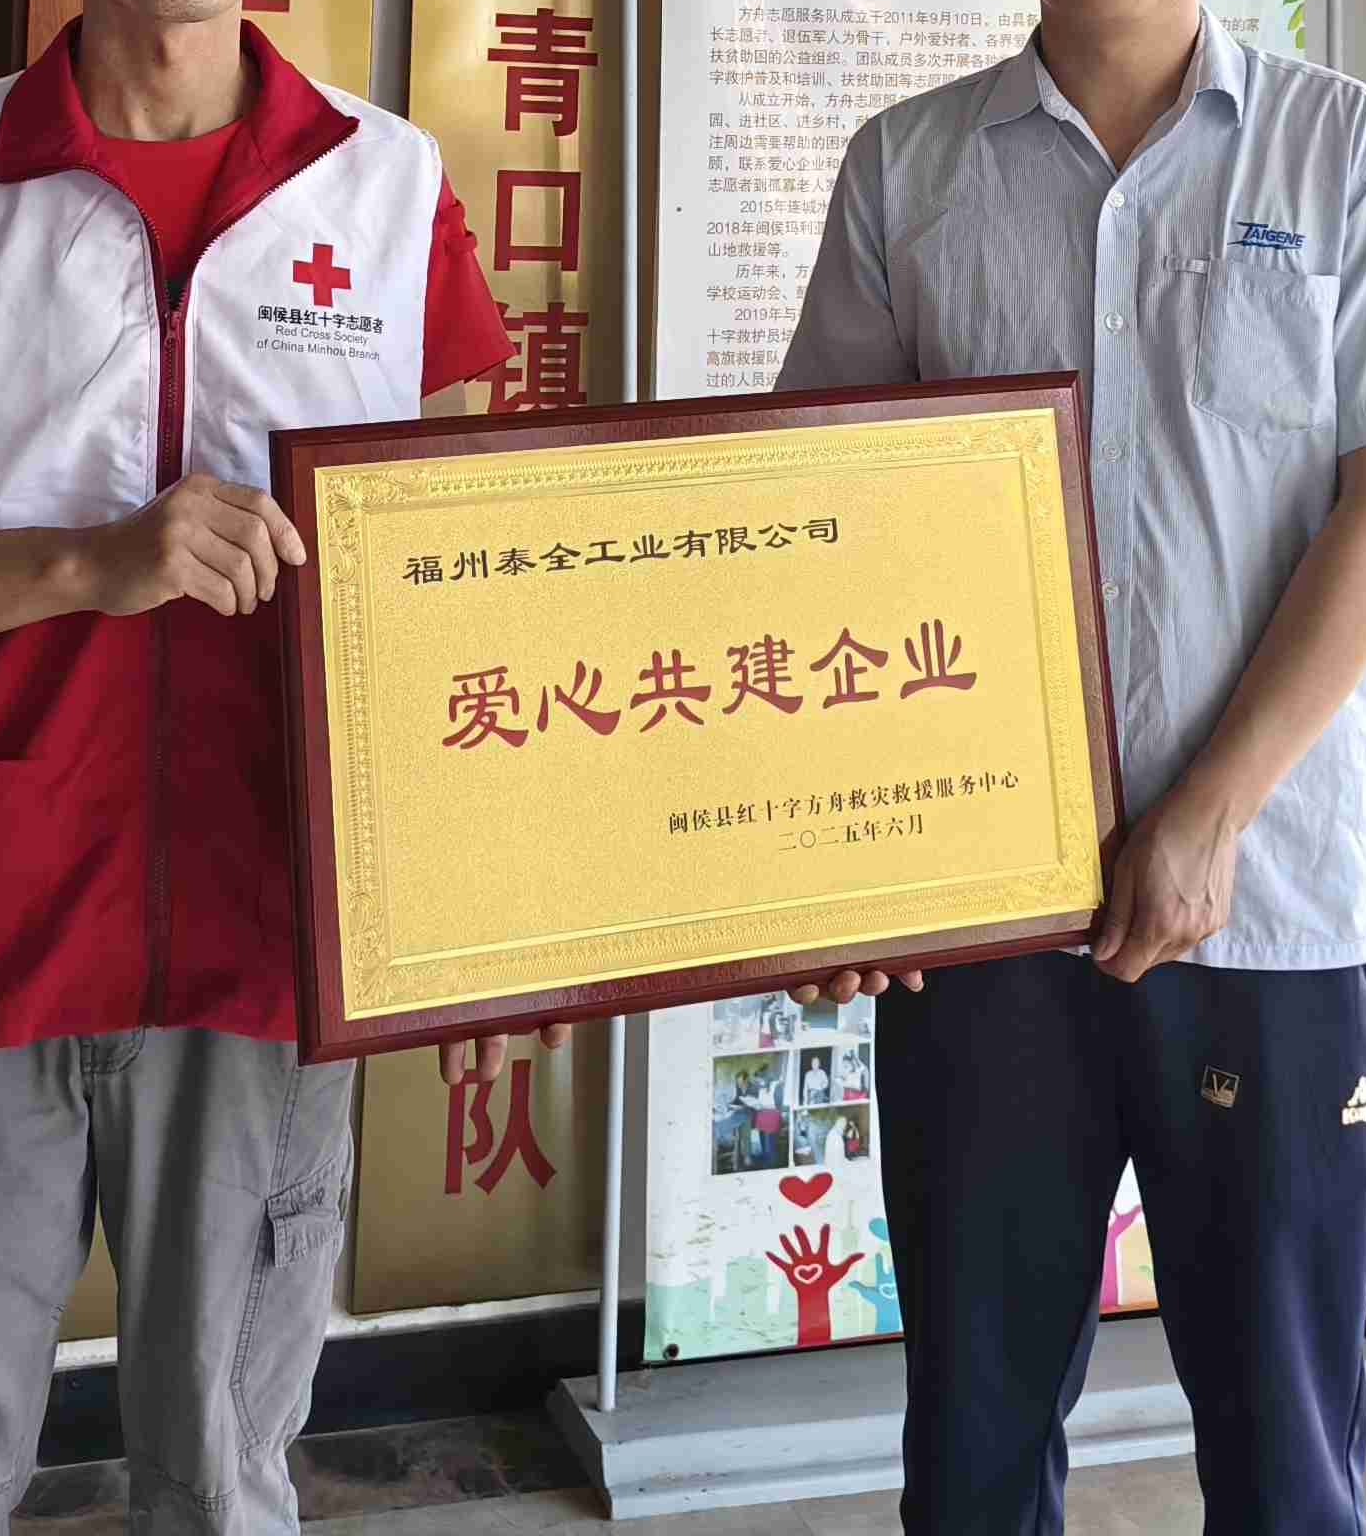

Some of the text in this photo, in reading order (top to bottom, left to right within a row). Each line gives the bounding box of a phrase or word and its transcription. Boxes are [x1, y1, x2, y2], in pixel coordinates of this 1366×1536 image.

[707, 156, 843, 172] 顾，联系爱心企业和
[257, 304, 384, 335] 闽侯县红十字志愿者
[275, 324, 369, 345] Red Cross Society
[256, 337, 380, 361] of China Minhou Branch
[403, 517, 840, 585] 福州泰全工业有限公司
[441, 618, 978, 751] 爱心共建企业
[668, 770, 1020, 835] 闽侯县红十字方舟救灾救援服务中心
